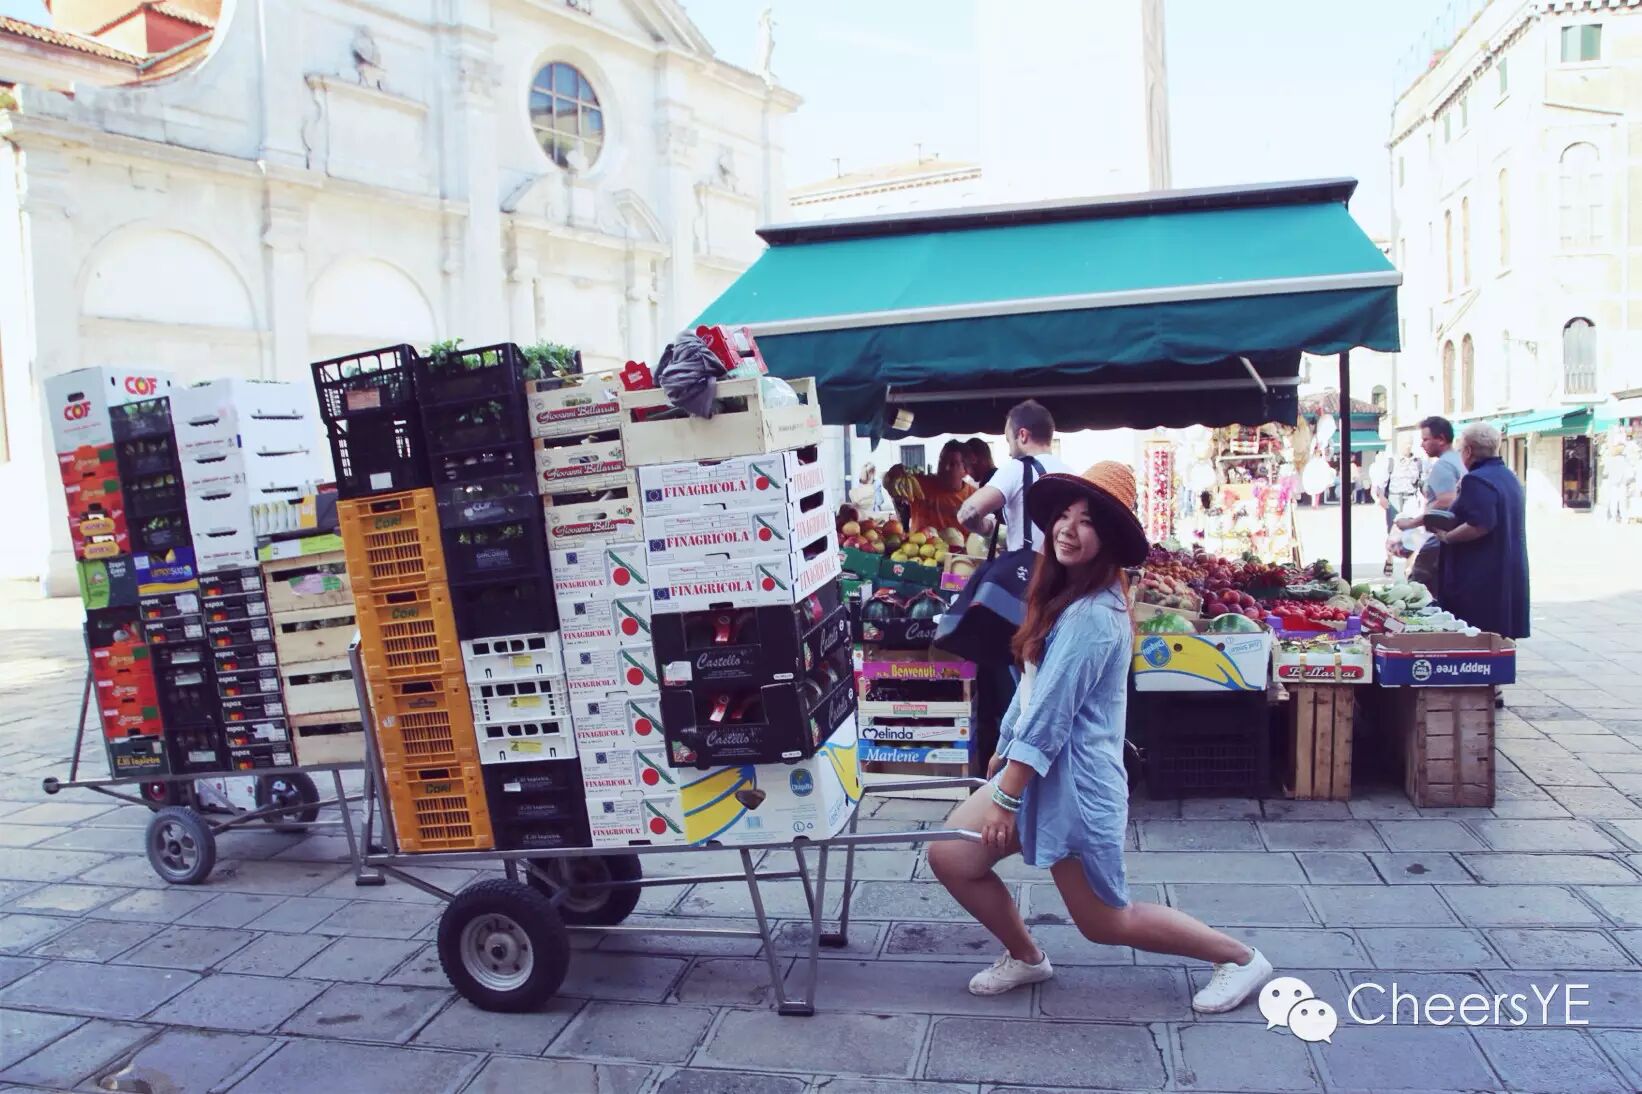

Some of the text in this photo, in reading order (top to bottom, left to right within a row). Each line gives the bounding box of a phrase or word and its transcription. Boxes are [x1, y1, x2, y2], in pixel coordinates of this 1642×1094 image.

[124, 375, 157, 396] COF
[64, 400, 91, 420] COF
[664, 480, 747, 498] FINAGRICOLA
[666, 530, 750, 548] FINAGRICOLA
[556, 580, 604, 590] FINAGRICOLA
[671, 580, 753, 597] FINAGRICOLA
[564, 630, 611, 640] FINAGRICOLA
[906, 622, 936, 640] Cast
[696, 652, 742, 670] Castello
[891, 664, 936, 677] Benvenuti
[1436, 665, 1458, 676] Tree
[1460, 663, 1491, 675] Happy
[569, 679, 616, 689] FINAGRICOLA
[578, 729, 625, 739] FINAGRICOLA
[706, 730, 750, 747] Castello
[862, 728, 913, 740] Melinda
[866, 748, 919, 762] Marlene
[585, 778, 633, 788] FINAGRICOLA
[592, 828, 640, 837] FINAGRICOLA
